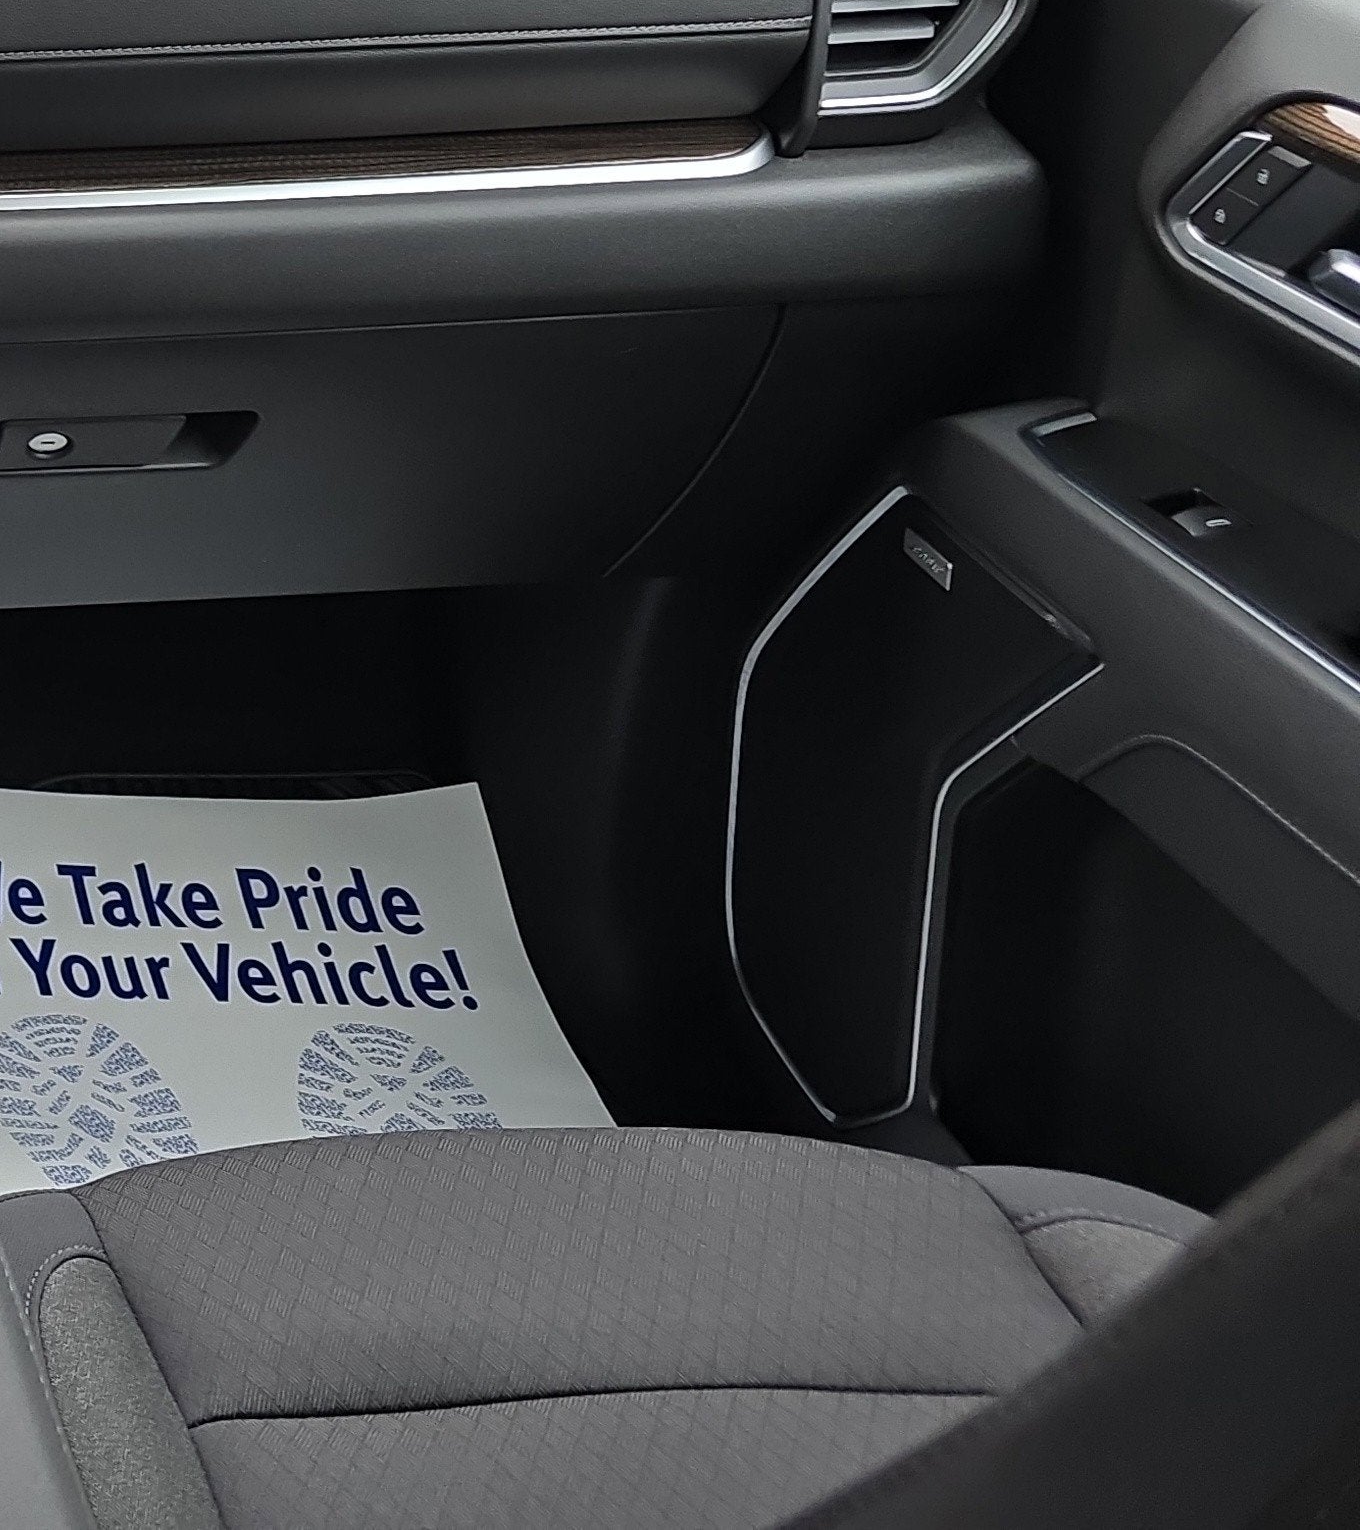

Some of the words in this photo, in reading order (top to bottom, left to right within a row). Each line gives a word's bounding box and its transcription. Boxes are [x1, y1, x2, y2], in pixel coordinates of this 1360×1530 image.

[56, 861, 221, 930] Take
[236, 866, 423, 937] Pride
[8, 938, 171, 1001] Your
[179, 941, 480, 1012] Vehicle!
